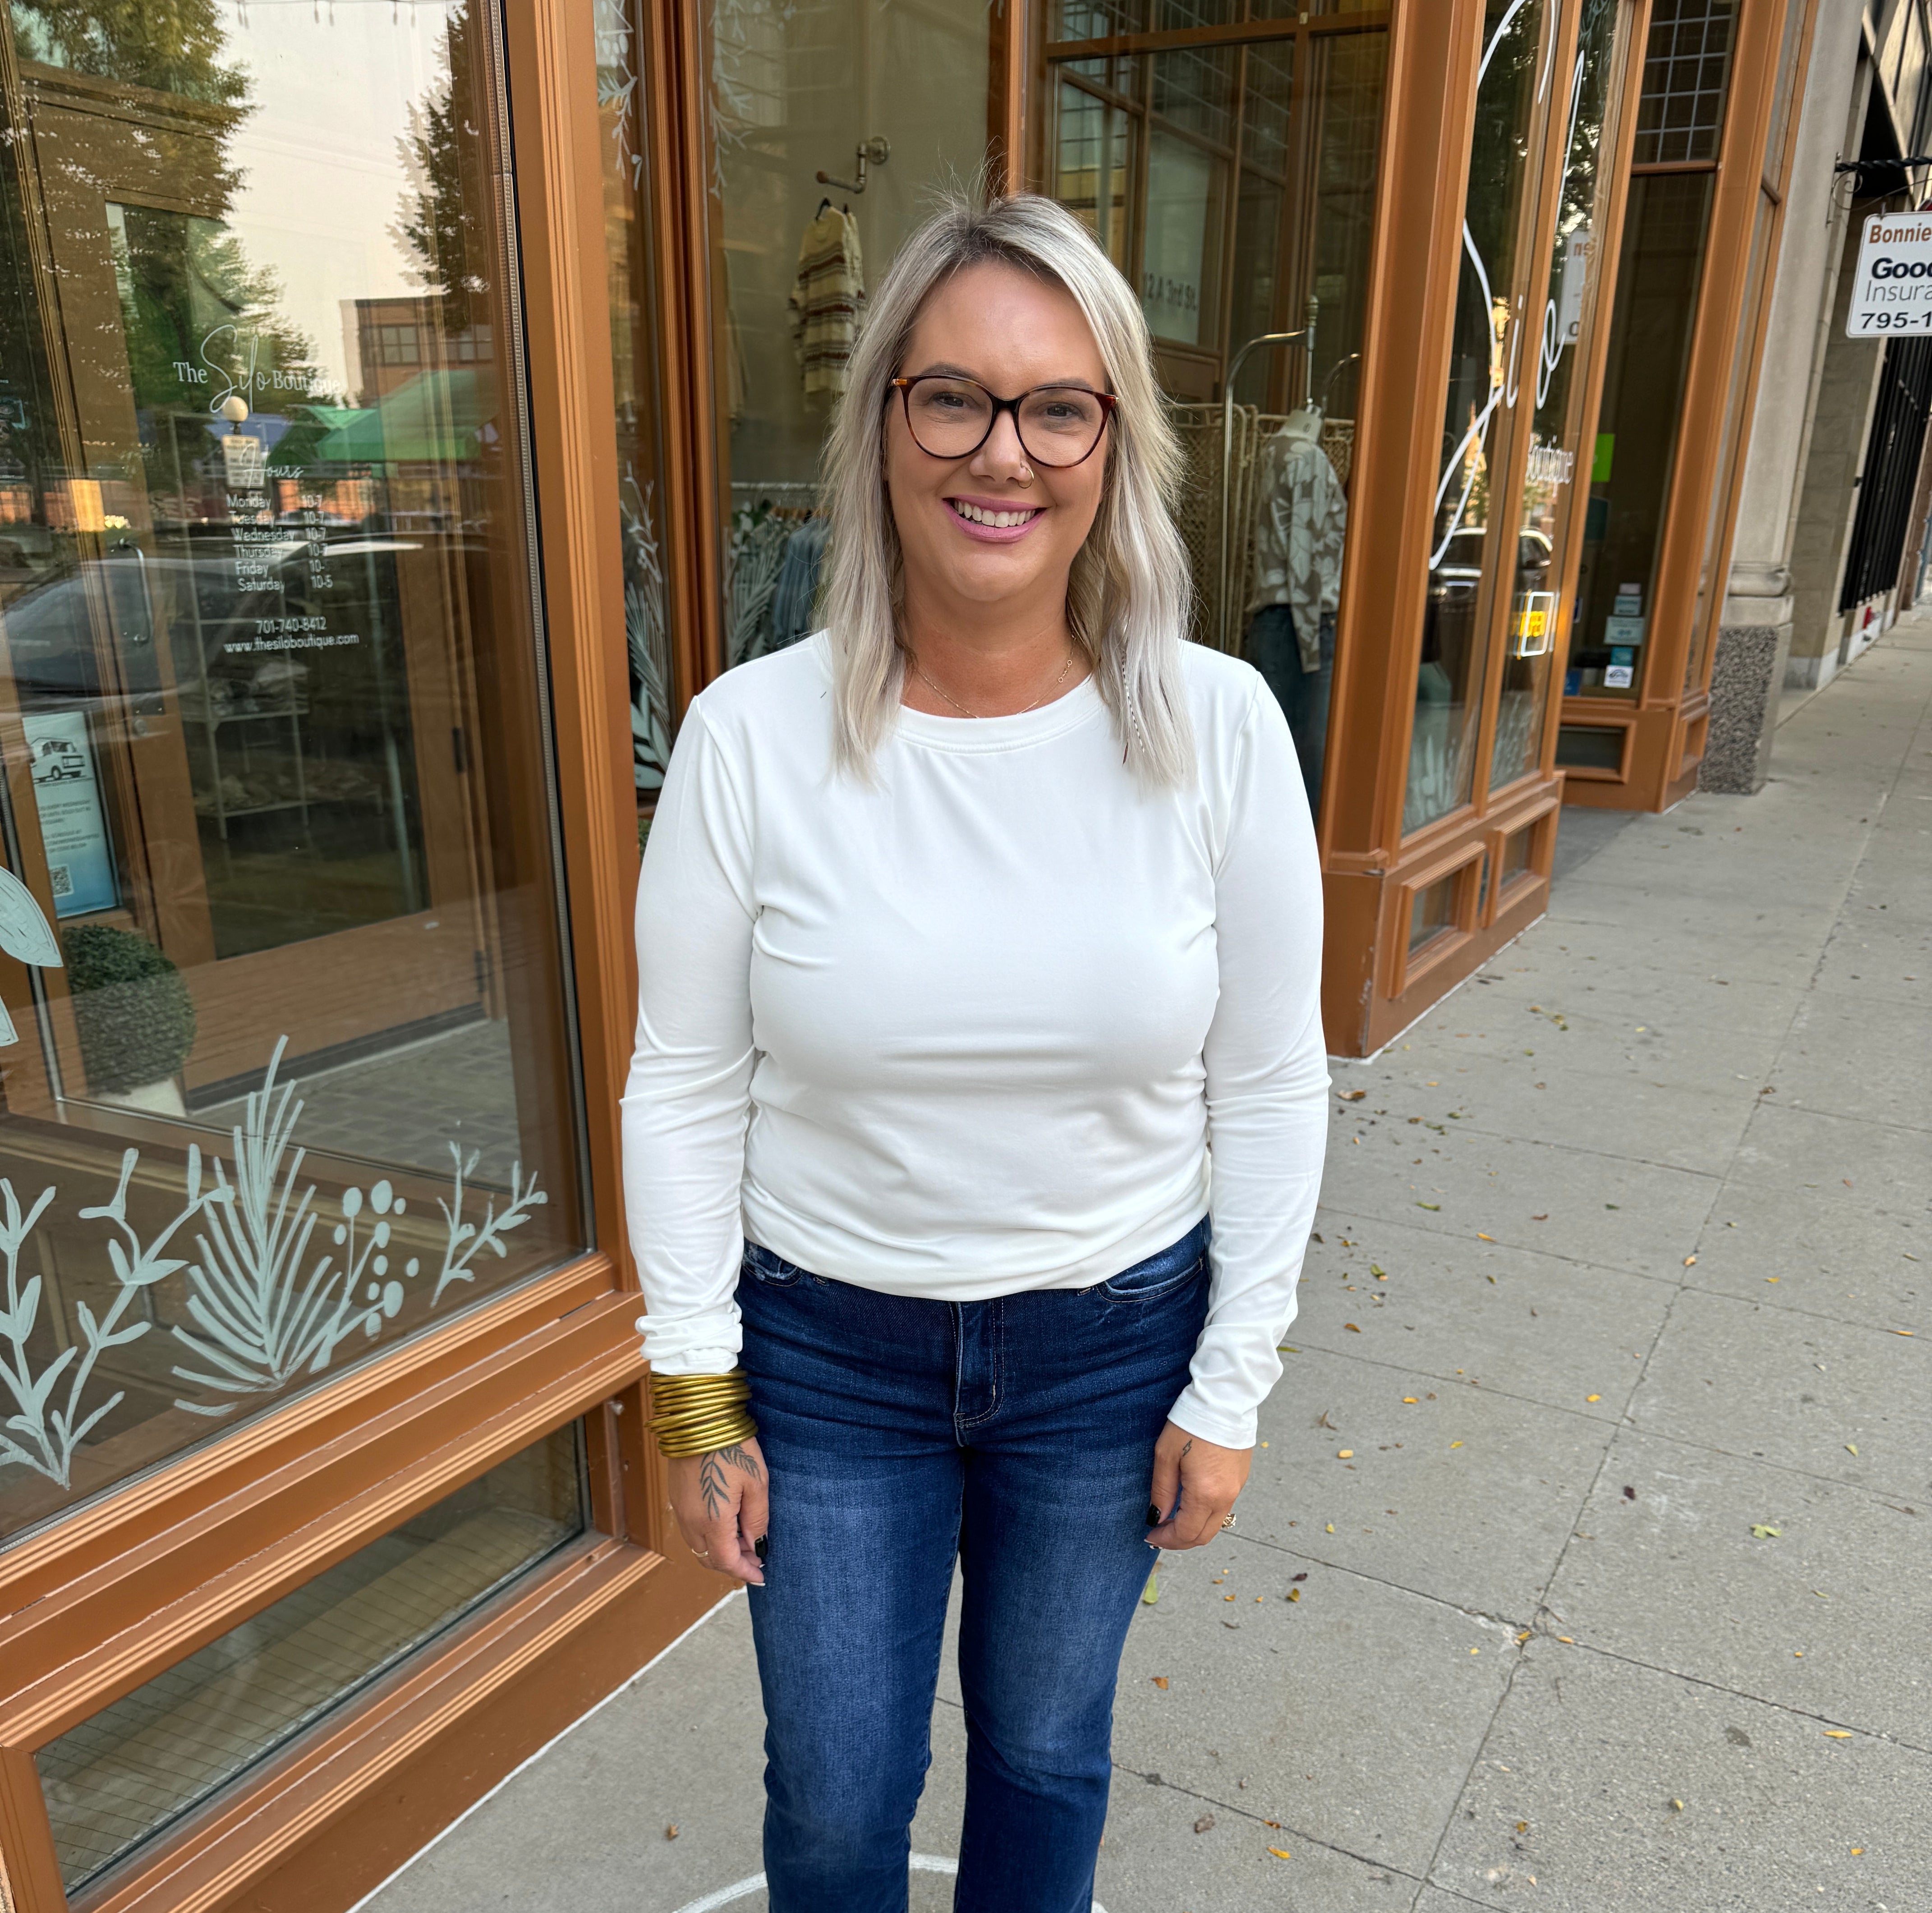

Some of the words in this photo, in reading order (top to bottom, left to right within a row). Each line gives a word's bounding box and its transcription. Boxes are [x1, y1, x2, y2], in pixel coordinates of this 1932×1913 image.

[1869, 222, 1932, 244] Bonnie
[1861, 311, 1932, 330] 795-1
[173, 362, 208, 384] The
[200, 324, 271, 413] Silo
[226, 493, 271, 510] Monday
[302, 494, 322, 508] 10-7
[228, 510, 275, 528] Tuesday
[303, 510, 324, 524] 10-7
[230, 527, 295, 543] Wednesday
[305, 526, 326, 540] 10-7
[233, 543, 283, 560] Thursday
[234, 560, 269, 578] Friday
[237, 576, 285, 594] Saturday
[310, 574, 333, 589] 10-5
[255, 616, 327, 634] 701-740-8412
[223, 633, 359, 653] www.thesiloboutique.com
